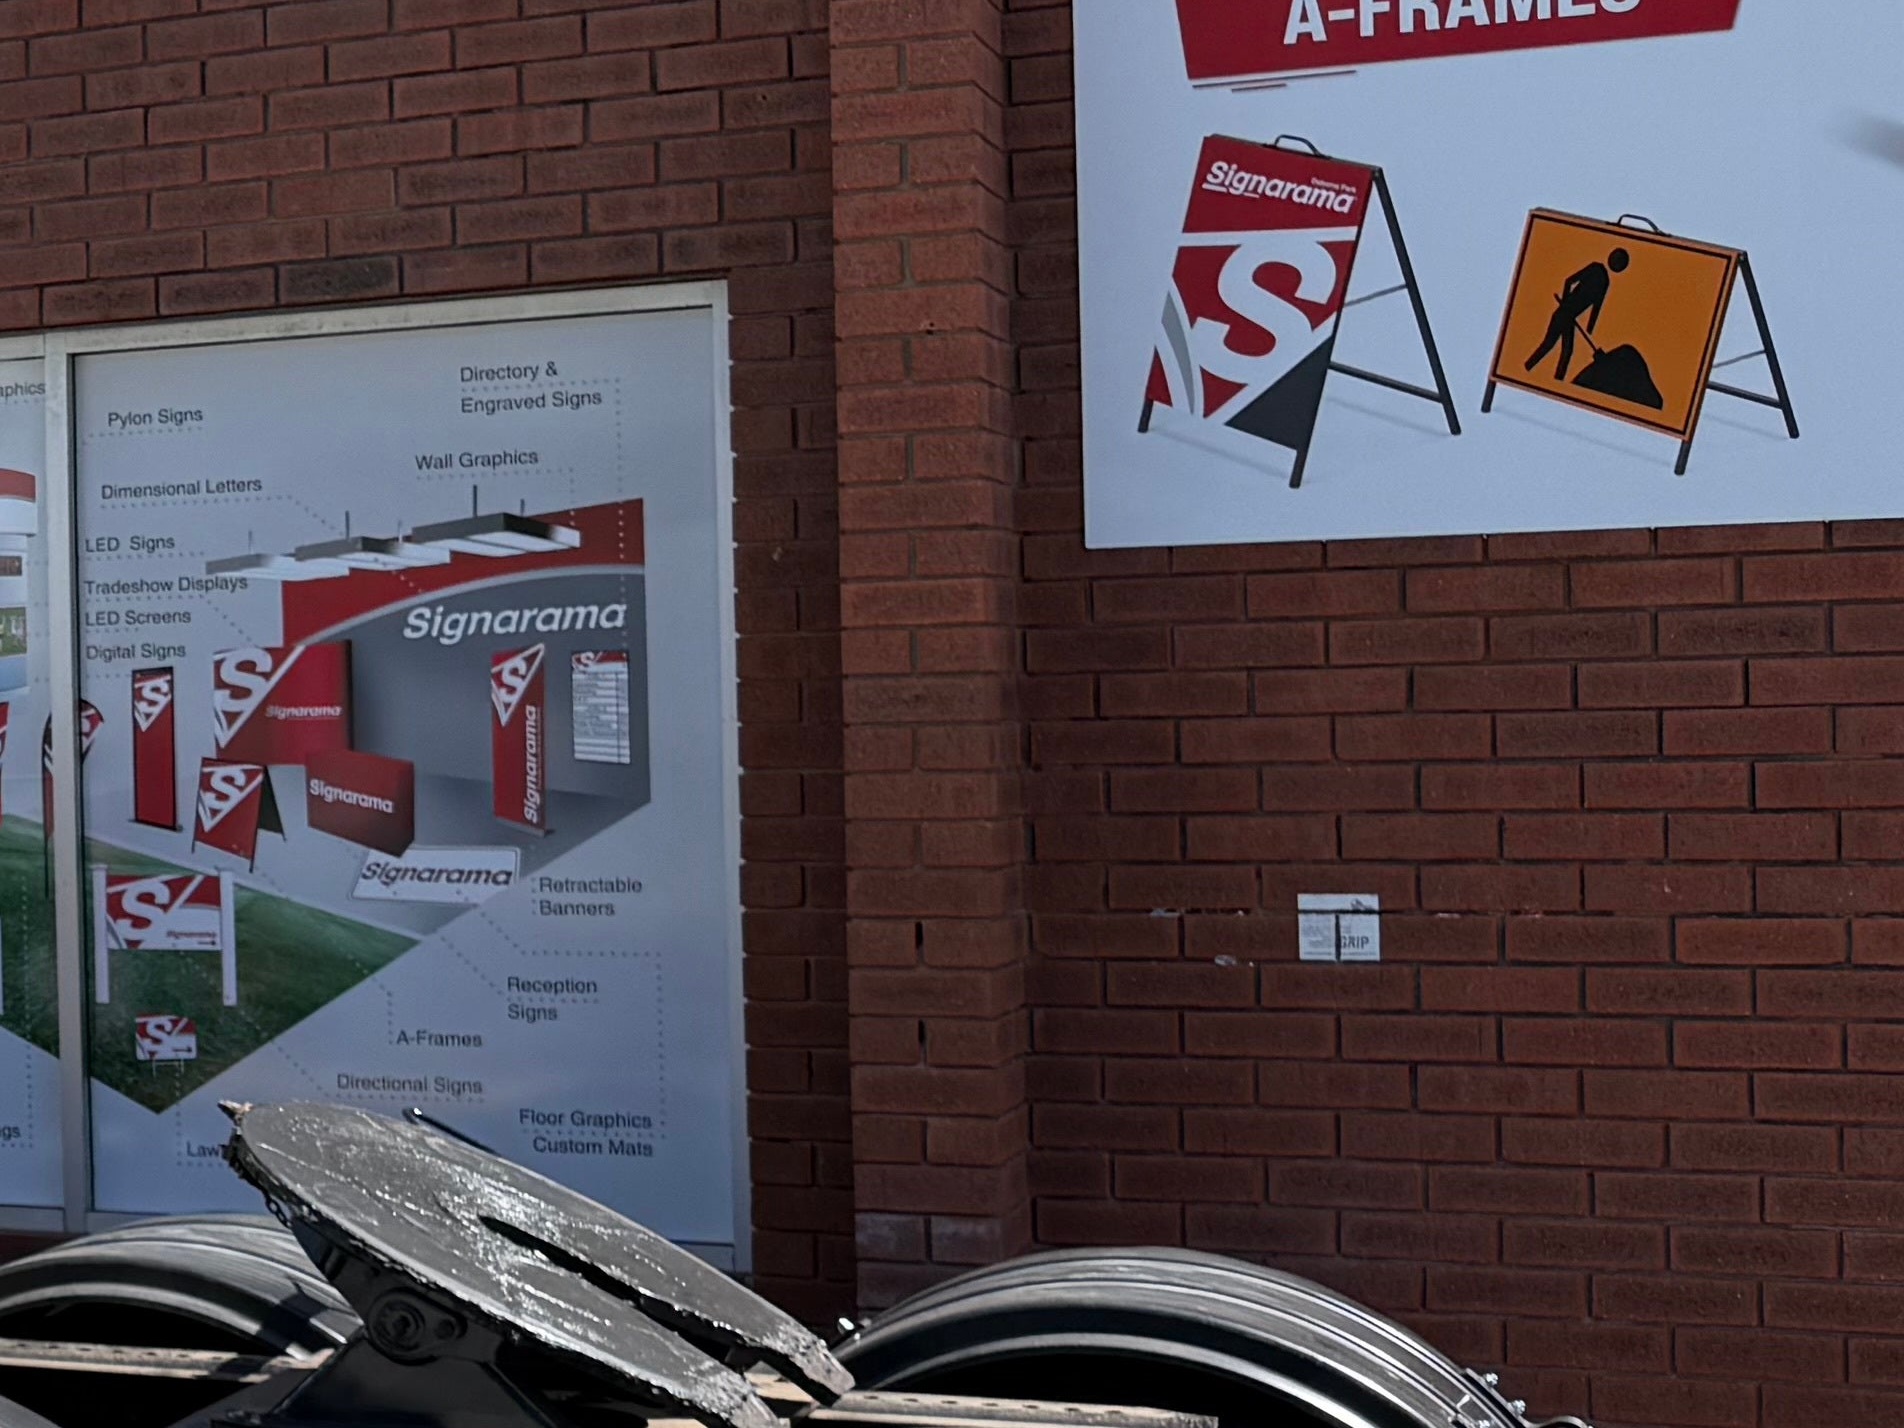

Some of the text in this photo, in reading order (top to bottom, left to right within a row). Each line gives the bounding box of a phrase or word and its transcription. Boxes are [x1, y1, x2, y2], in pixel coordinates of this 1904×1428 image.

[1205, 160, 1355, 214] Signarama
[460, 361, 558, 383] Directory &
[461, 390, 603, 415] Engraved Signs
[108, 408, 204, 429] Pylon Signs
[415, 449, 539, 471] Wall Graphics
[101, 478, 263, 500] Dimensional Letters
[85, 536, 175, 553] LED Signs
[84, 576, 249, 595] Tradeshow Displays
[85, 610, 192, 627] LED Screens
[403, 603, 628, 645] Signarama
[86, 643, 187, 662] Digital Signs
[310, 779, 394, 813] Signarama
[361, 861, 513, 888] Signarama
[540, 877, 643, 894] Retractable
[540, 900, 616, 916] Banners
[507, 977, 598, 996] Reception
[508, 1003, 558, 1023] Signs
[396, 1029, 482, 1047] A-Frames
[337, 1074, 483, 1095] Directional Signs
[519, 1109, 652, 1130] Floor Graphics
[186, 1141, 221, 1158] Law
[533, 1137, 654, 1157] Custom Mats
